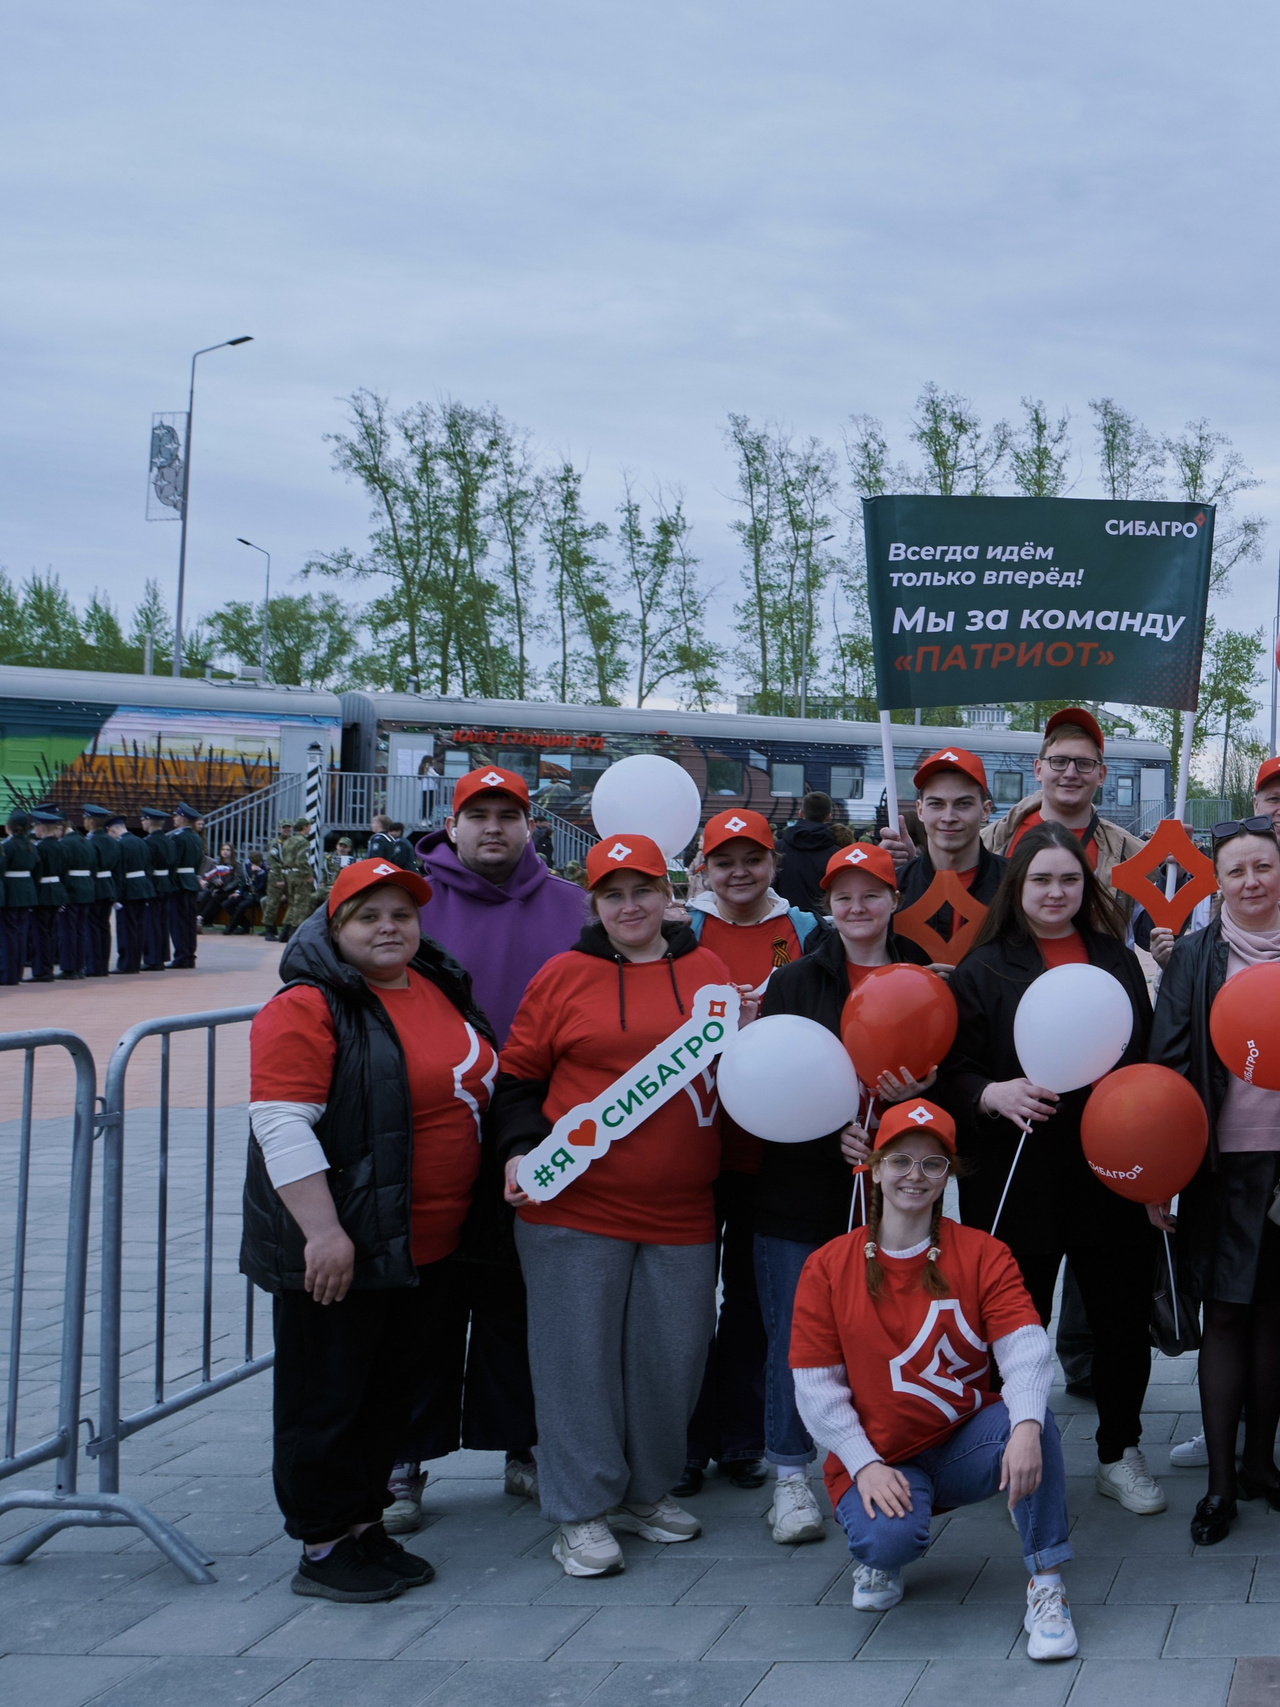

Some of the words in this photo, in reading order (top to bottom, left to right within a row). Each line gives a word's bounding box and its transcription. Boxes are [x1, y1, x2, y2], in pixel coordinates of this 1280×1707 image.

[1105, 518, 1198, 539] СИБАГРО
[888, 542, 979, 563] Всегда
[986, 541, 1054, 562] идём
[889, 570, 976, 588] только
[983, 567, 1085, 589] вперёд!
[892, 606, 955, 634] Мы
[965, 609, 1009, 632] за
[1019, 608, 1187, 643] команду
[894, 641, 1115, 673] «ПАТРИОТ»
[452, 730, 499, 744] КАФЕ
[501, 732, 574, 748] СТАНЦИЯ
[533, 1146, 576, 1188] #Я
[601, 1020, 725, 1128] СИБАГРО
